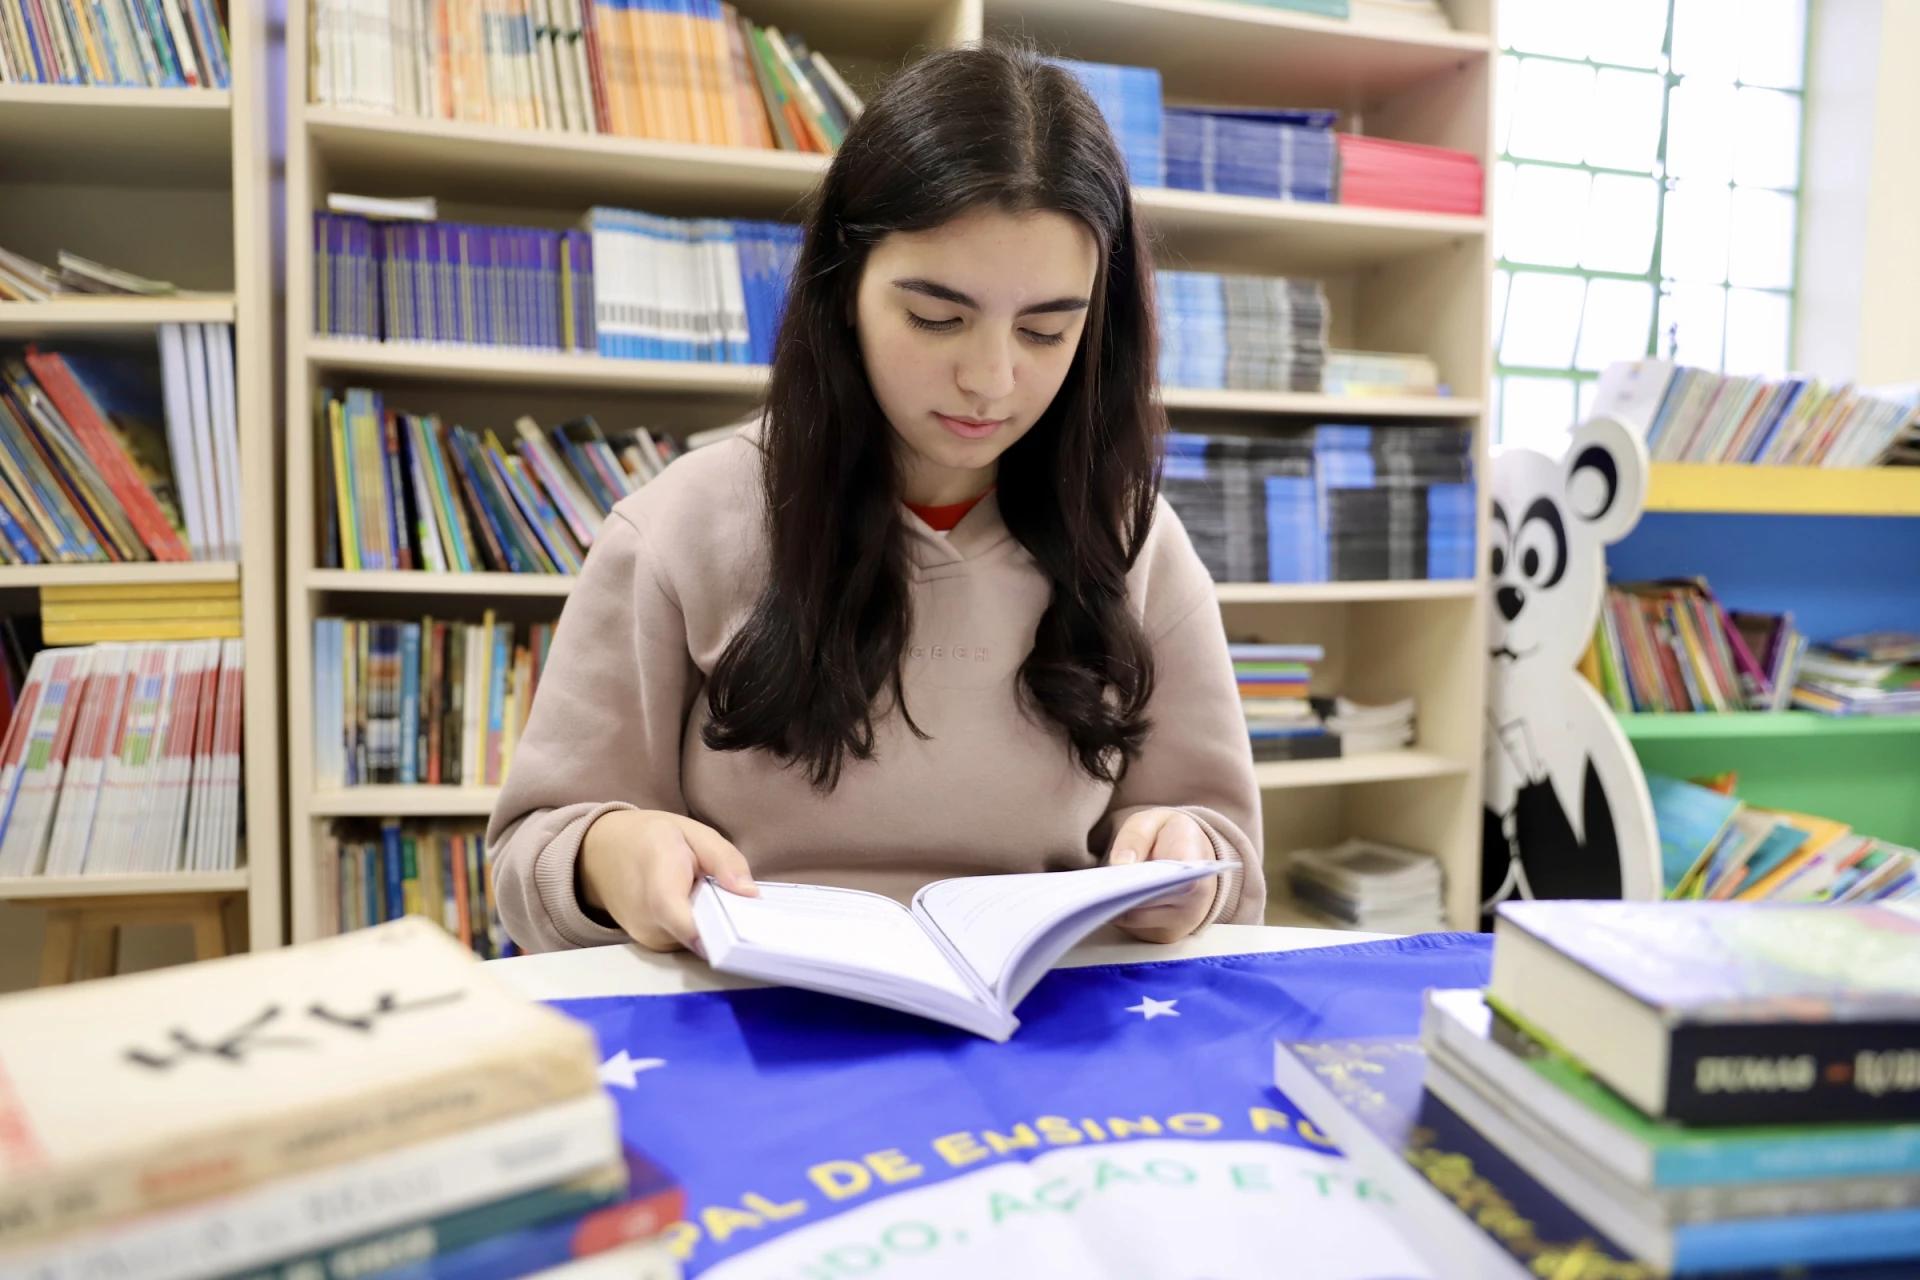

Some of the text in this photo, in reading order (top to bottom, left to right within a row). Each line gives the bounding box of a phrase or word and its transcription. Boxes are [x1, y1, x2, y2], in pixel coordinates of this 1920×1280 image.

[1695, 1055, 1815, 1093] DUMAS
[807, 1149, 923, 1201] DE
[934, 1113, 1222, 1166] ENSINO
[1230, 1164, 1273, 1191] E
